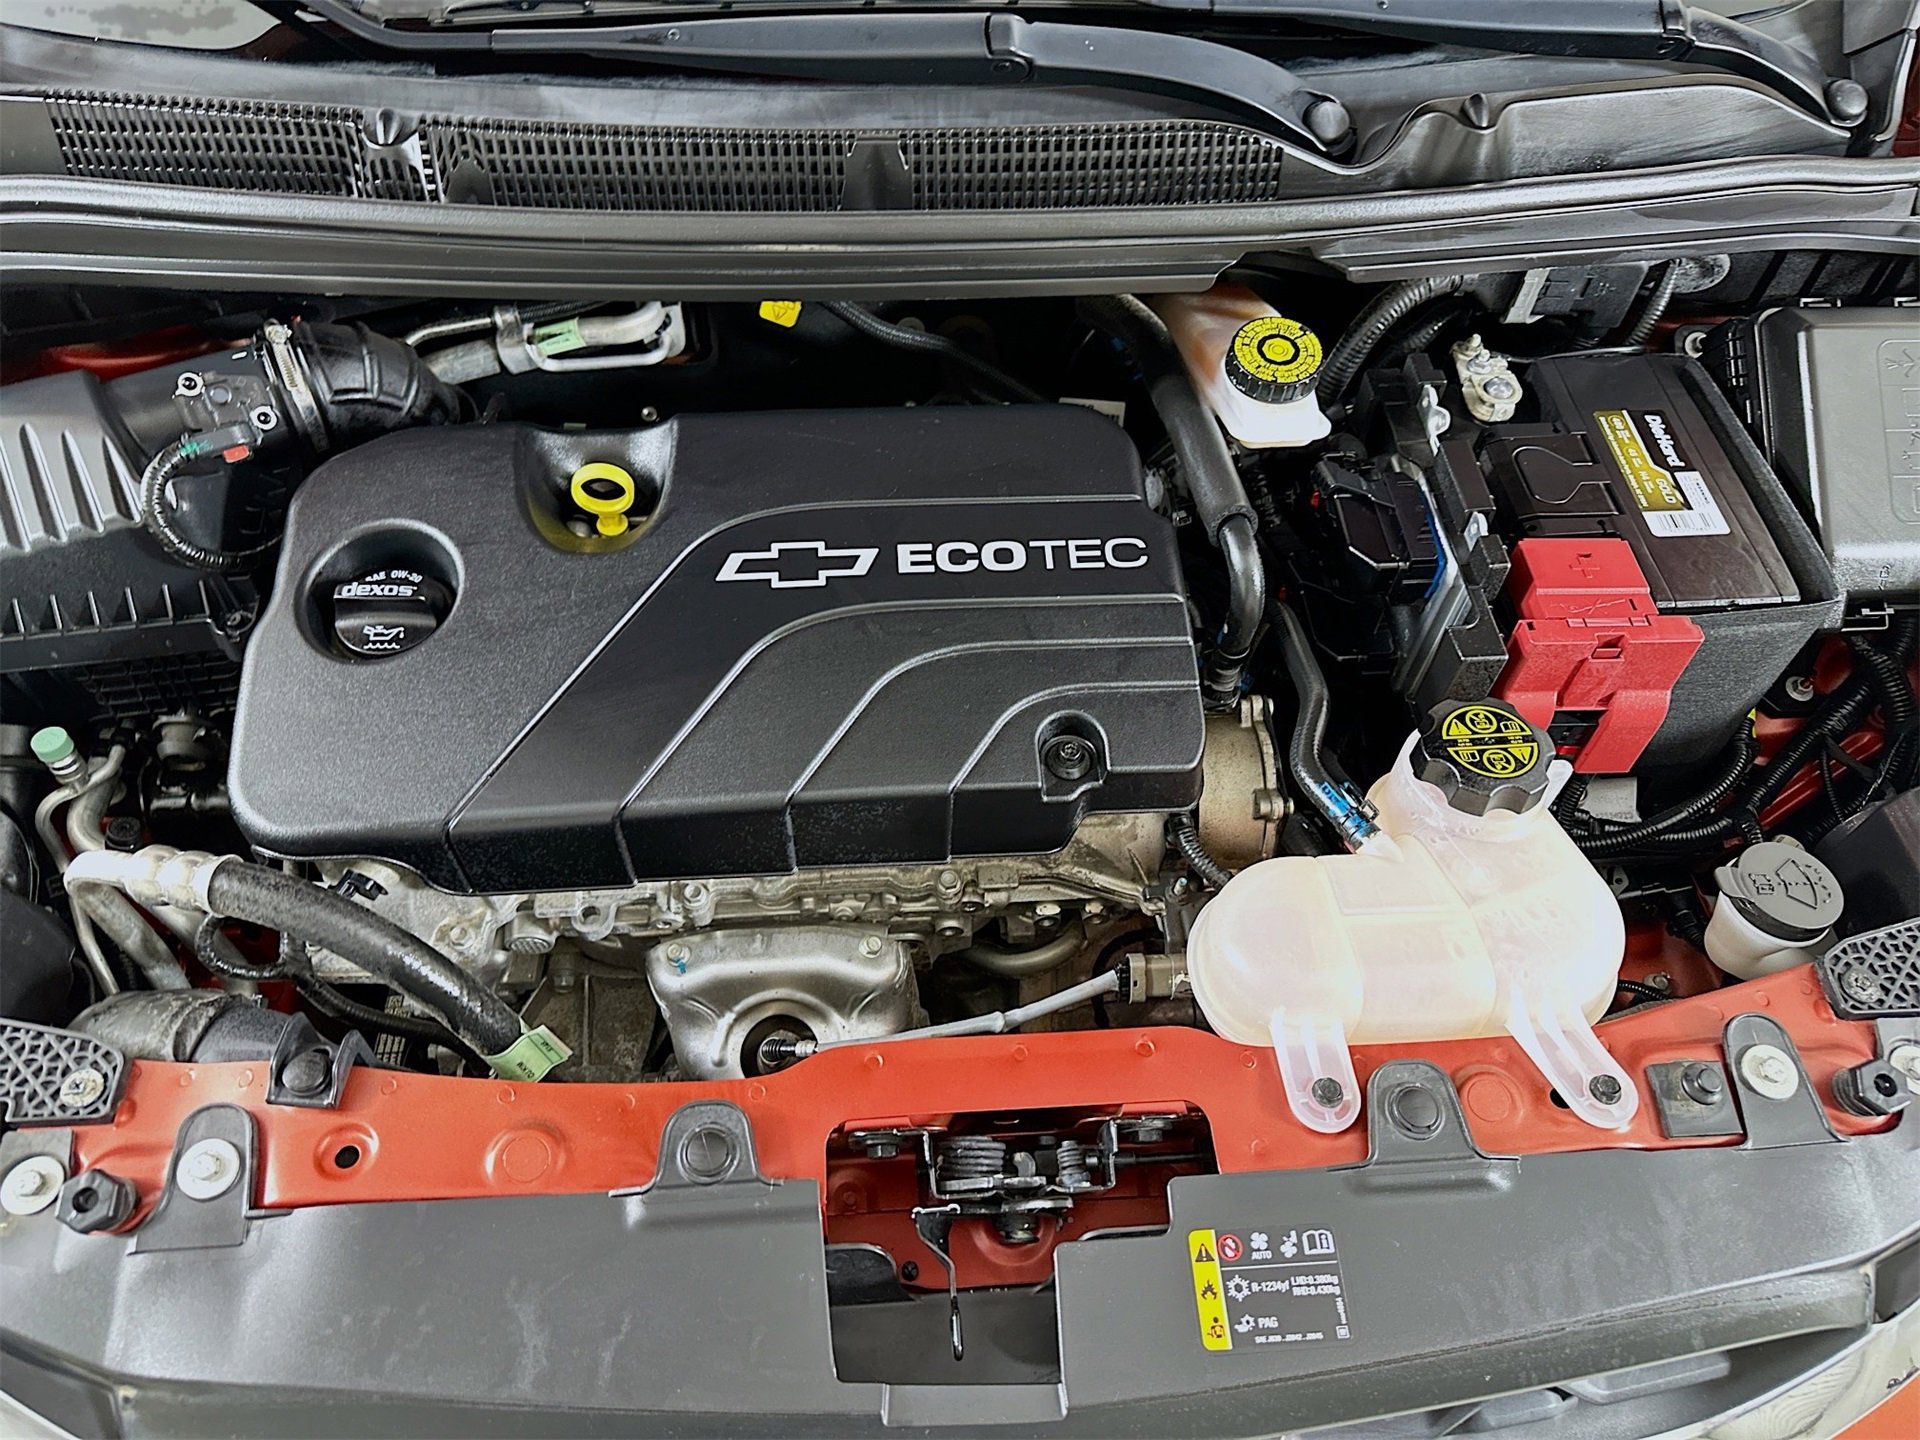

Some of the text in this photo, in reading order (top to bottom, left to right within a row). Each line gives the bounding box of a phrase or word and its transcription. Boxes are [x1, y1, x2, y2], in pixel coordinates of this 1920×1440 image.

[1644, 414, 1686, 467] DieHard
[1655, 478, 1678, 504] GOLD
[897, 537, 1149, 574] ECOTEC
[341, 582, 414, 597] dexos
[1251, 1250, 1273, 1260] AUTO
[1257, 1317, 1279, 1329] PAG
